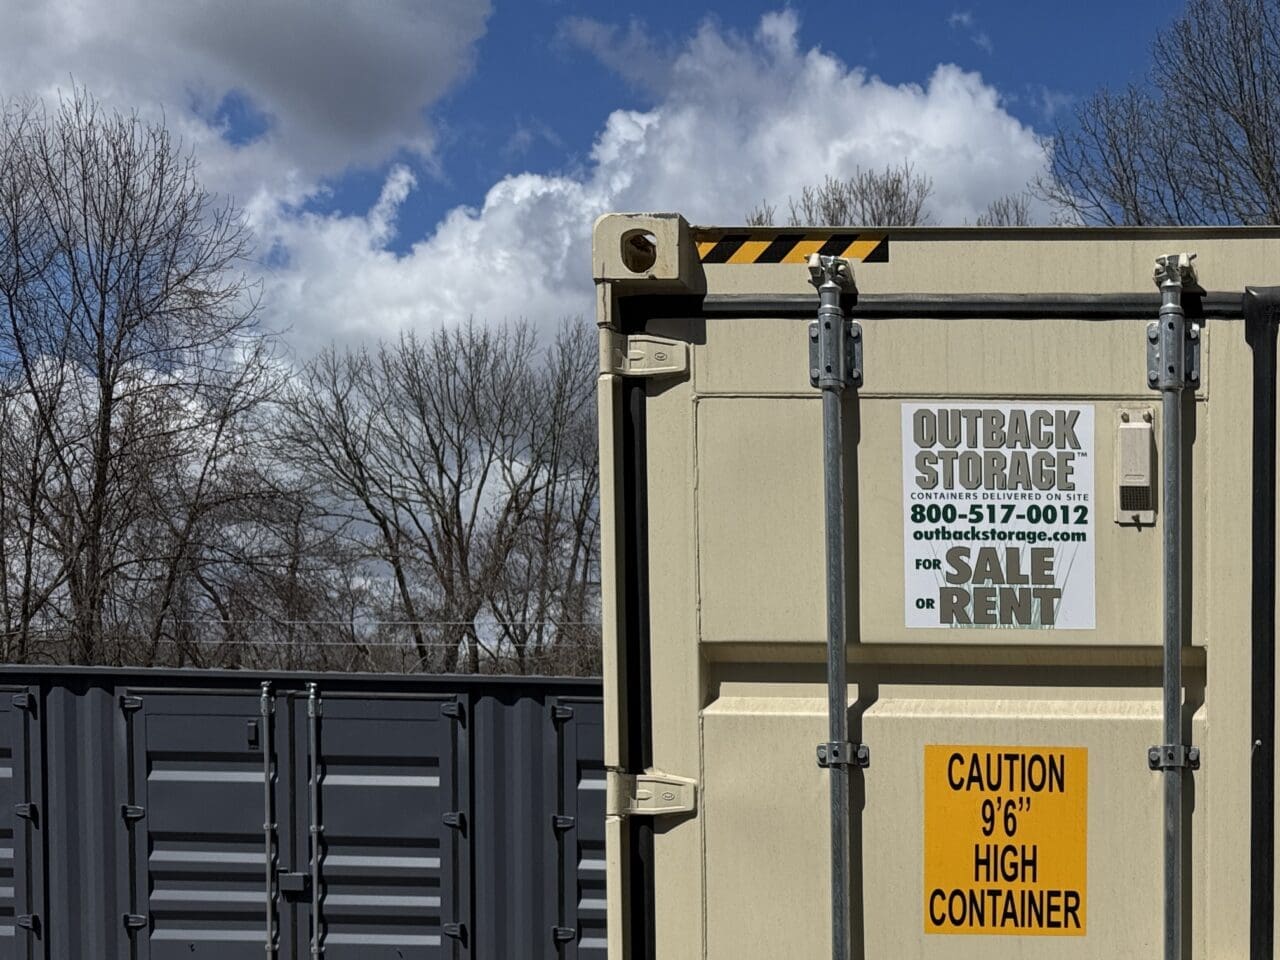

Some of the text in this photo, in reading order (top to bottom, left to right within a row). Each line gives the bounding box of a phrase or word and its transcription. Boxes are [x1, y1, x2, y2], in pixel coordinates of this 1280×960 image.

[913, 409, 1081, 449] OUTBACK
[915, 451, 1075, 491] STORAGE
[911, 492, 977, 500] CONTAINERS
[983, 493, 1041, 501] DELIVERED
[1046, 493, 1061, 501] ON
[911, 504, 1088, 524] 800-517-0012
[913, 526, 1086, 544] outbackstorage.com
[916, 546, 1055, 585] FOR SALE
[916, 587, 1061, 625] OR RENT
[948, 753, 1064, 792] CAUTION
[975, 844, 1037, 883] HIGH
[930, 889, 1081, 928] CONTAINER
